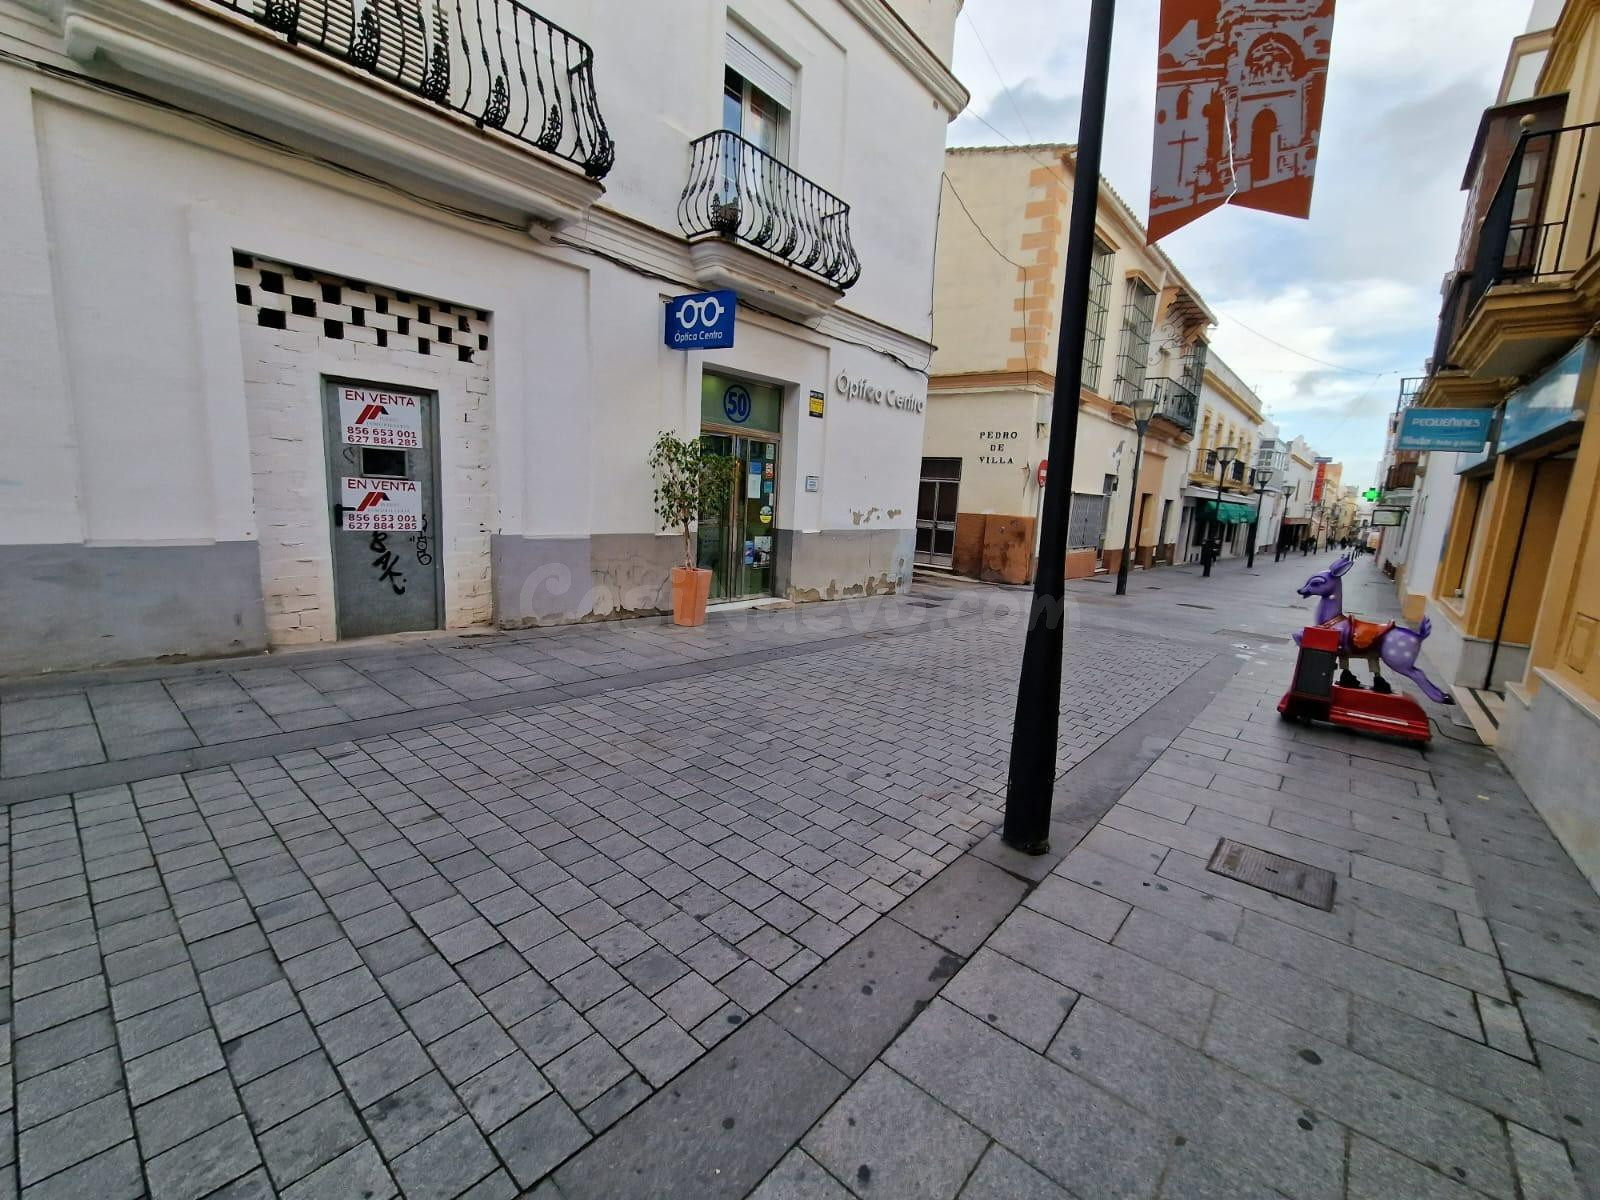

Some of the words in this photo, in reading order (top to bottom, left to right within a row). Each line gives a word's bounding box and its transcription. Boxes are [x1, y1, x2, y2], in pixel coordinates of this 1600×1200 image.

[699, 330, 723, 340] Centro
[836, 368, 882, 404] Óptica
[886, 389, 924, 413] Centro
[345, 389, 365, 402] EN
[369, 393, 416, 407] VENTA
[727, 391, 747, 417] 50
[347, 426, 369, 435] 856
[373, 428, 394, 437] 653
[397, 430, 417, 439] 001
[979, 431, 1018, 440] PEDRO
[347, 434, 369, 443] 627
[373, 436, 394, 445] 884
[397, 438, 418, 447] 285
[990, 443, 1005, 452] DE
[979, 456, 1014, 464] VILLA
[348, 478, 367, 489] EN
[371, 480, 416, 492] VENTA
[348, 513, 370, 522] 856
[373, 514, 394, 522] 653
[397, 514, 417, 522] 001
[348, 522, 370, 530] 627
[373, 522, 394, 530] 884
[397, 522, 417, 530] 285
